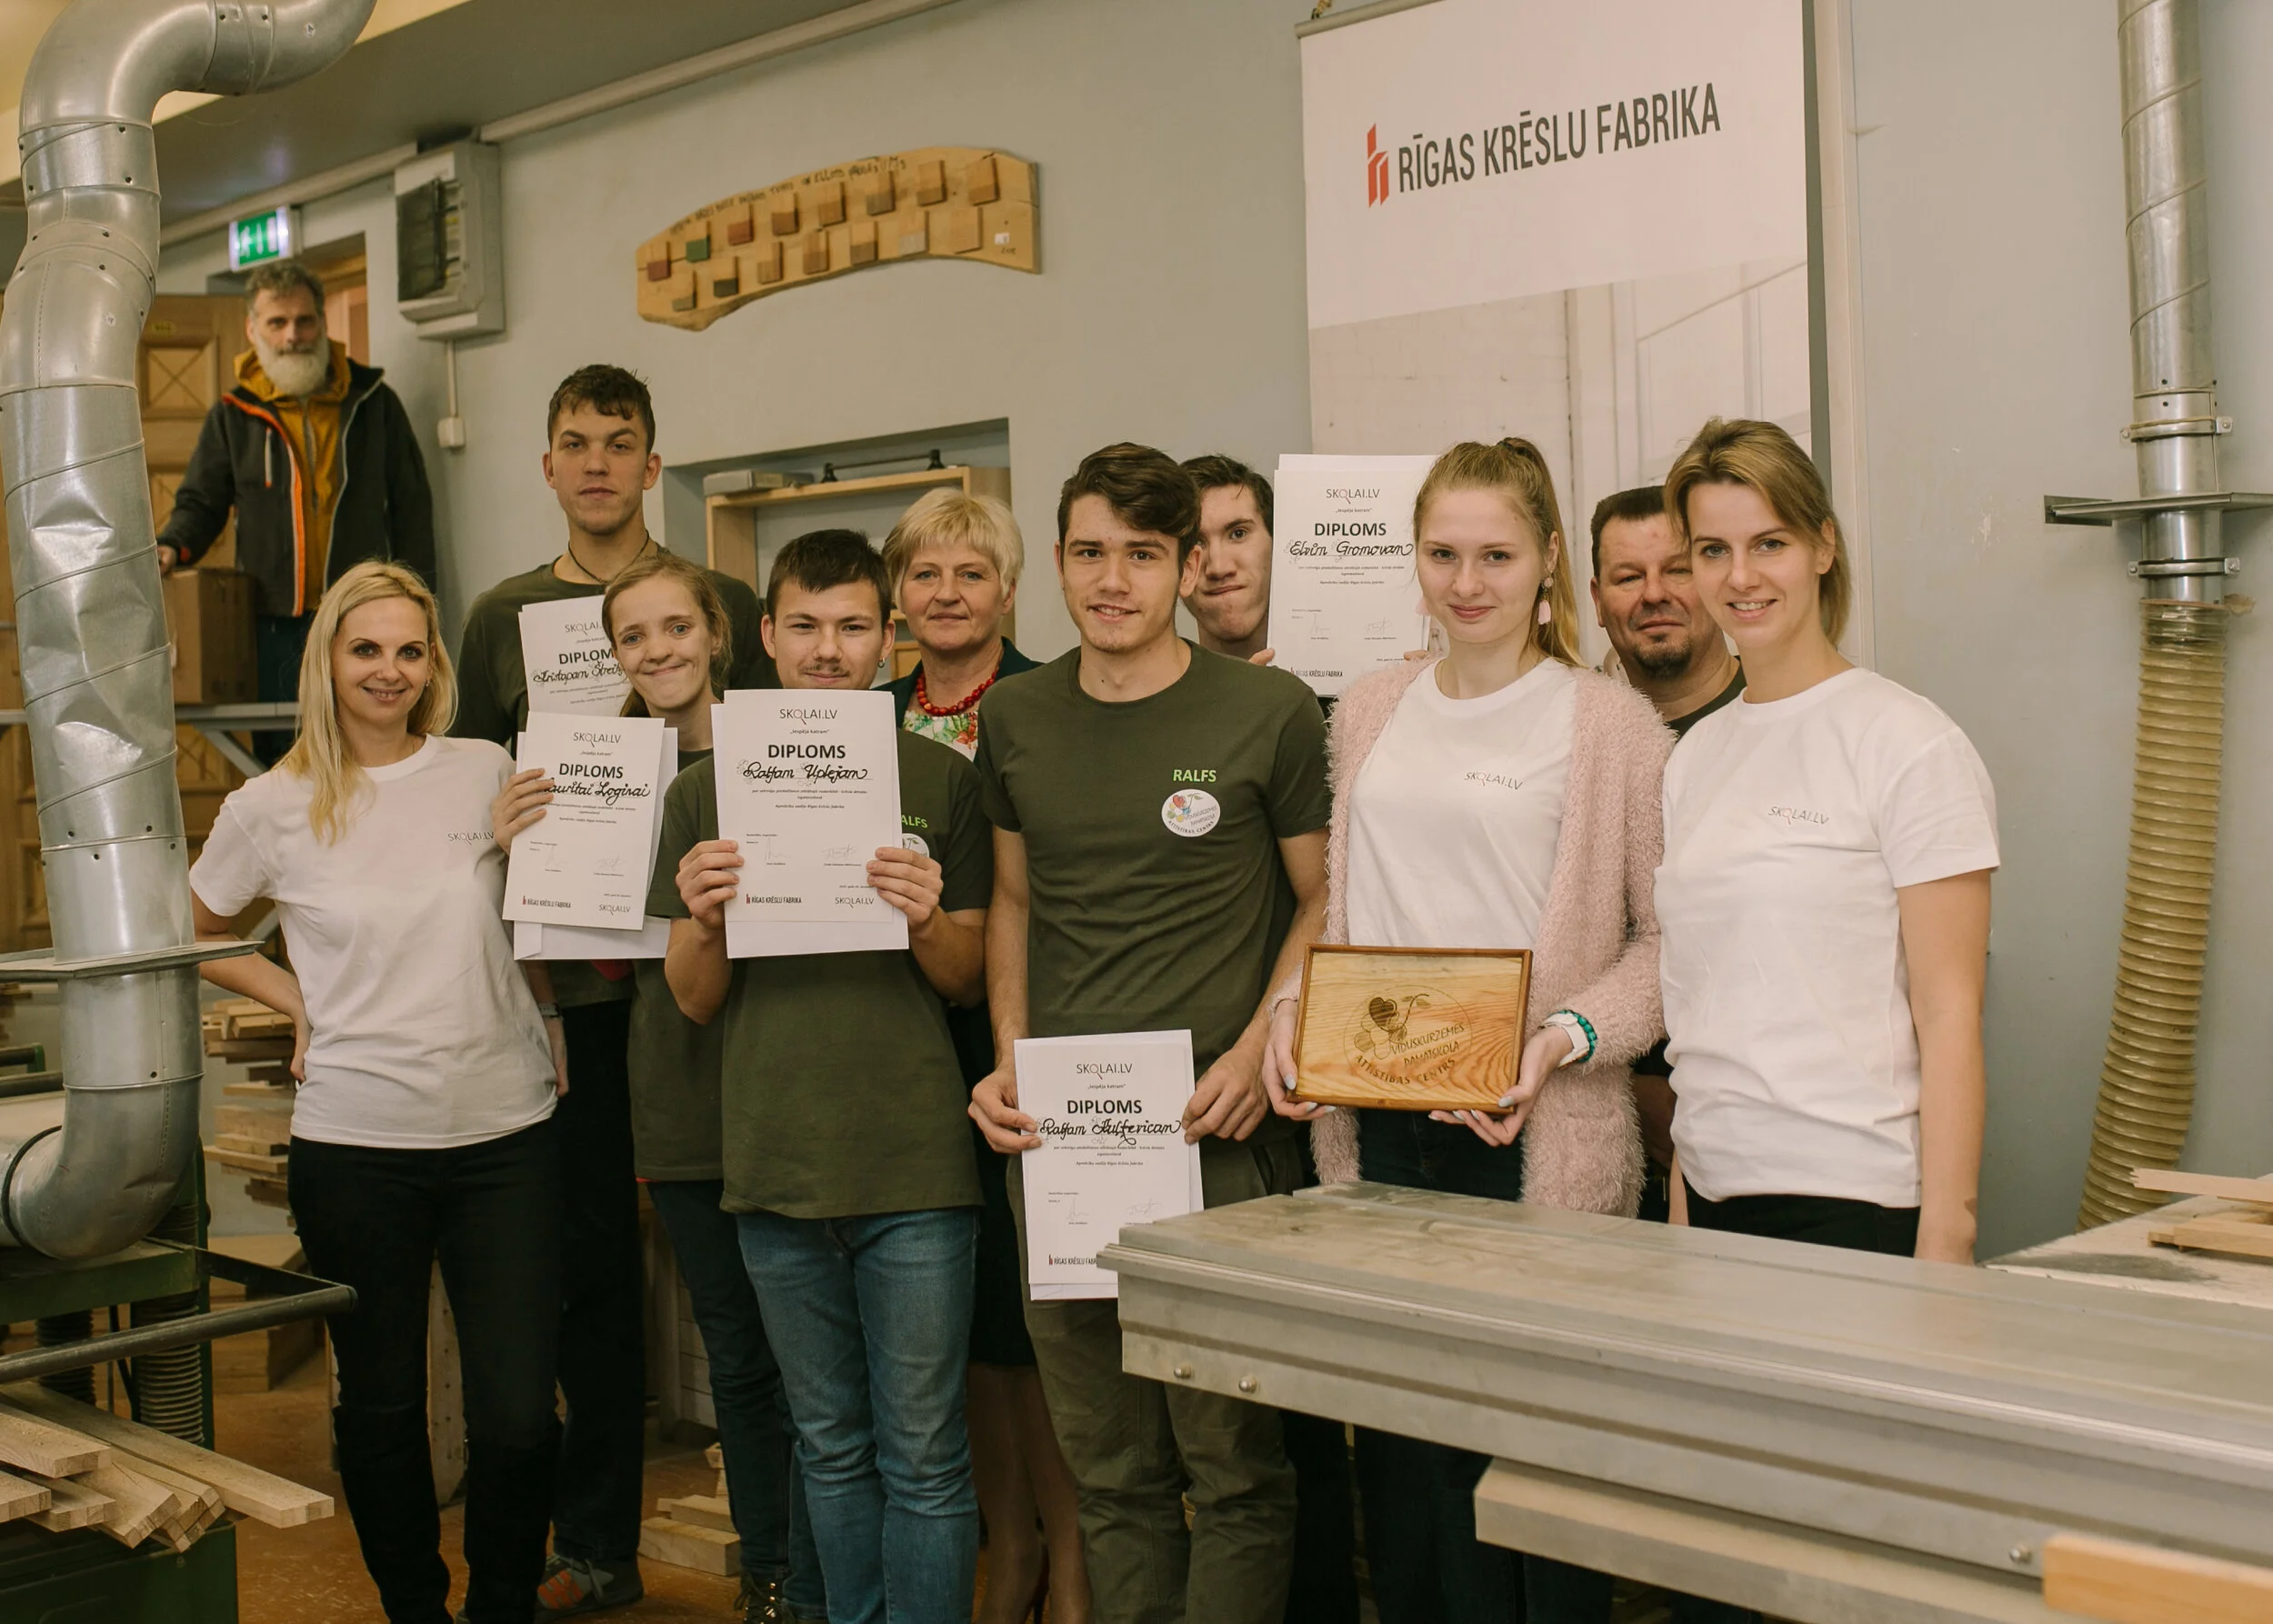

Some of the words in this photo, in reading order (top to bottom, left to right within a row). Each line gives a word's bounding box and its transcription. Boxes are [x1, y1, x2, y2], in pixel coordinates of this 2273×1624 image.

[1398, 134, 1476, 193] RĪGAS
[1483, 110, 1587, 176] KRĒSLU
[1597, 82, 1721, 155] FABRIKA
[1315, 523, 1387, 536] DIPLOMS
[565, 621, 603, 636] SKOLAI.
[558, 647, 615, 665] DIPLOM
[768, 744, 846, 758] DIPLOMS
[559, 763, 624, 779] DIPLOMS
[1173, 769, 1217, 782] RALFS
[901, 815, 928, 828] ALFS
[1066, 1099, 1143, 1115] DIPLOMS
